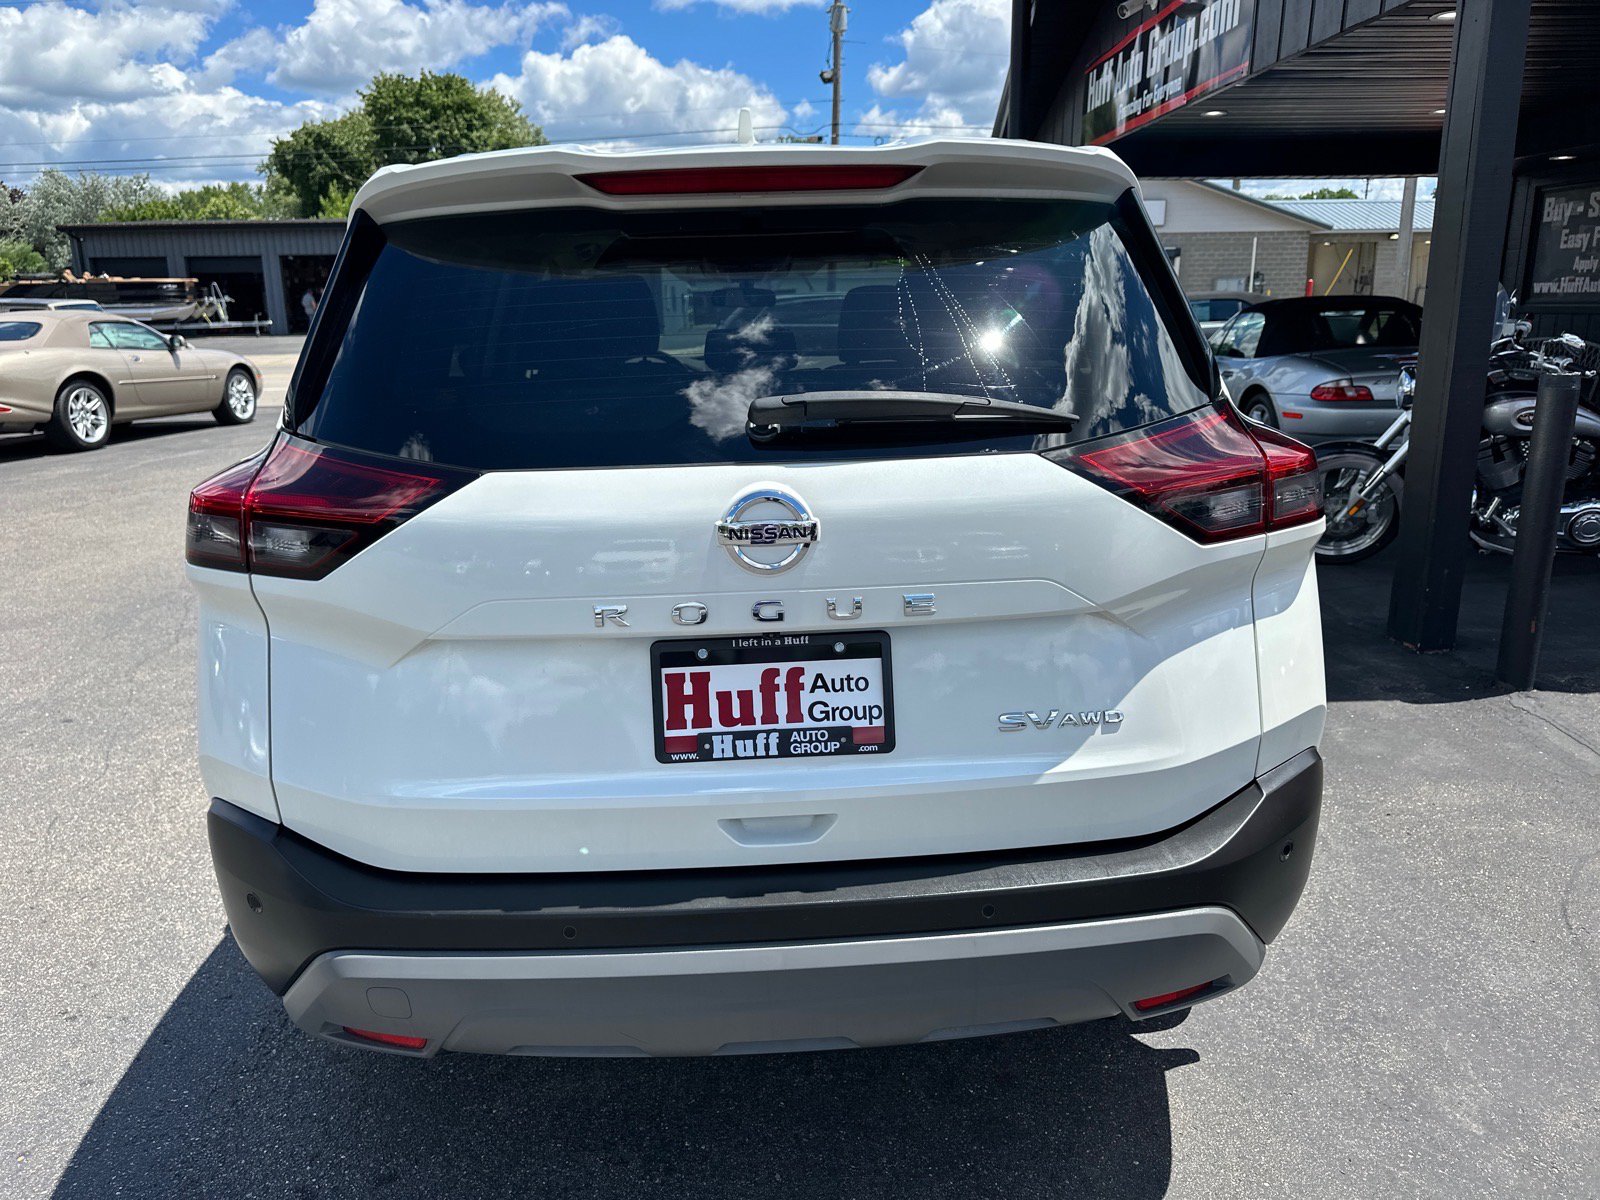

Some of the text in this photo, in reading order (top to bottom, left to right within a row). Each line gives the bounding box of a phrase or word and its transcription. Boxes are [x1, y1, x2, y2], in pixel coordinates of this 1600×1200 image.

[1087, 58, 1114, 113] Huff
[1113, 51, 1144, 98] Auto
[1542, 197, 1573, 226] Buy
[1560, 228, 1590, 252] Easy
[1572, 255, 1599, 273] Apply
[728, 527, 807, 541] NISSAN
[592, 592, 937, 628] ROGUE
[738, 638, 758, 647] left
[761, 637, 772, 646] in
[774, 638, 781, 646] a
[784, 636, 809, 645] Huff
[809, 673, 870, 694] Auto
[664, 666, 805, 731] Huff
[807, 700, 883, 726] Group
[998, 709, 1124, 732] SV AWD
[711, 732, 780, 759] Huff
[790, 730, 829, 743] AUTO
[790, 741, 841, 754] GROUP
[858, 744, 878, 752] .com
